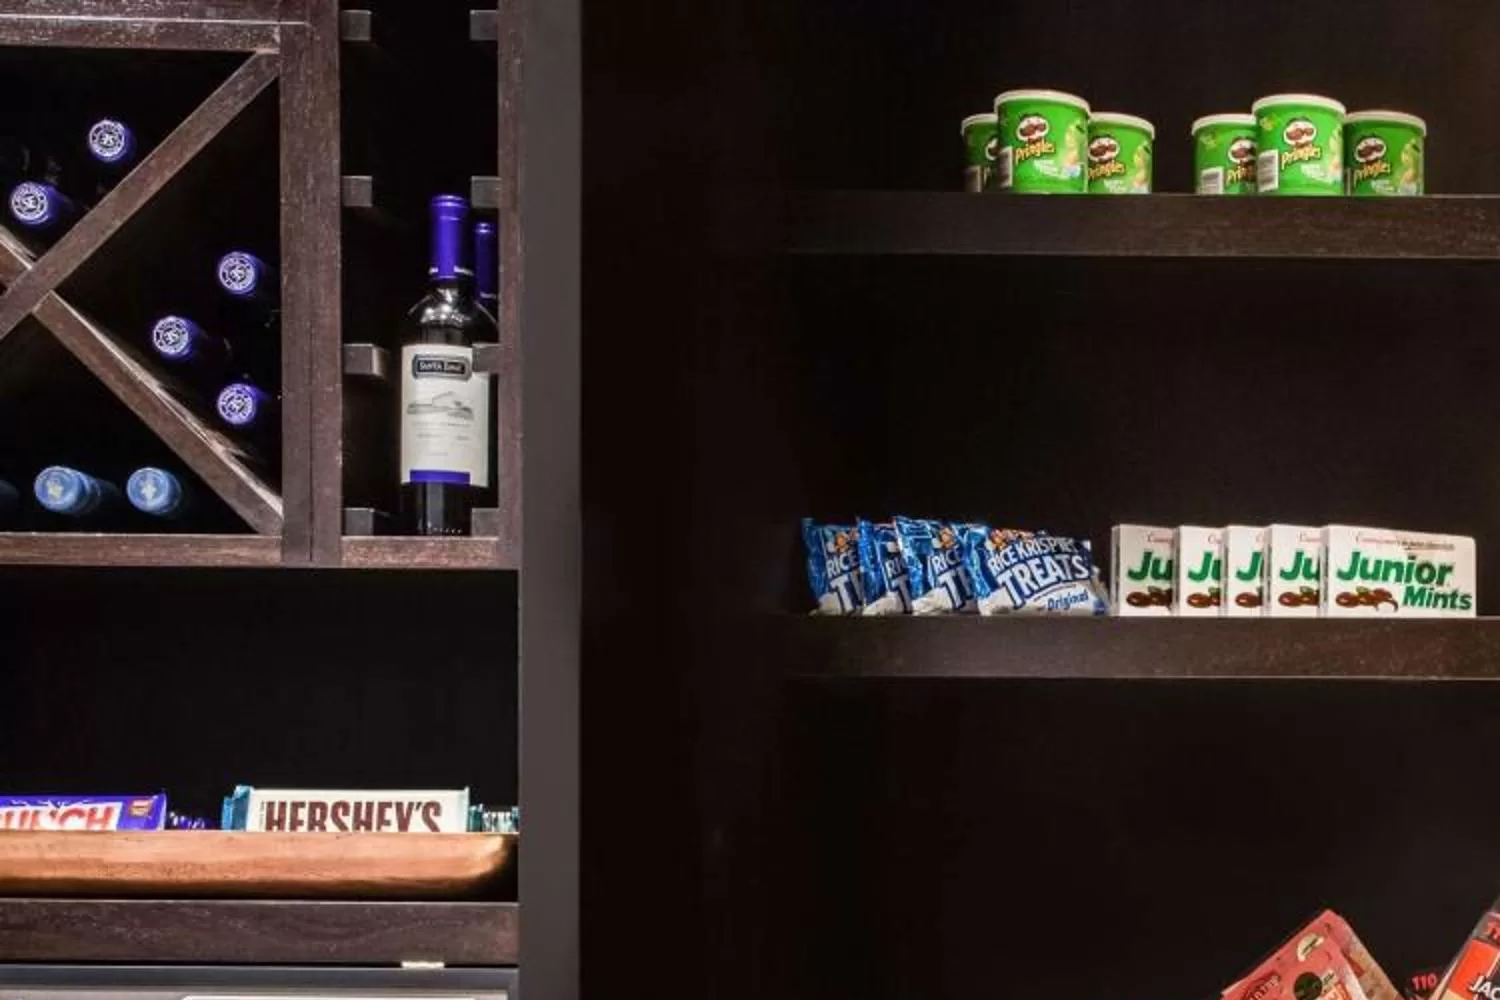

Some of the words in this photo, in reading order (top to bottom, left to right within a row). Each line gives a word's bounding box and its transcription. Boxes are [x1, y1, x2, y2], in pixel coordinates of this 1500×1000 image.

[1015, 139, 1055, 167] Pringles
[1281, 145, 1321, 170] Pringles
[987, 544, 1019, 576] RICE
[1337, 551, 1455, 585] Junior
[998, 552, 1091, 609] TREATS
[1047, 588, 1090, 610] Original
[1402, 584, 1473, 610] Mints
[264, 800, 442, 832] HERSHEY'S
[1412, 973, 1438, 990] 110
